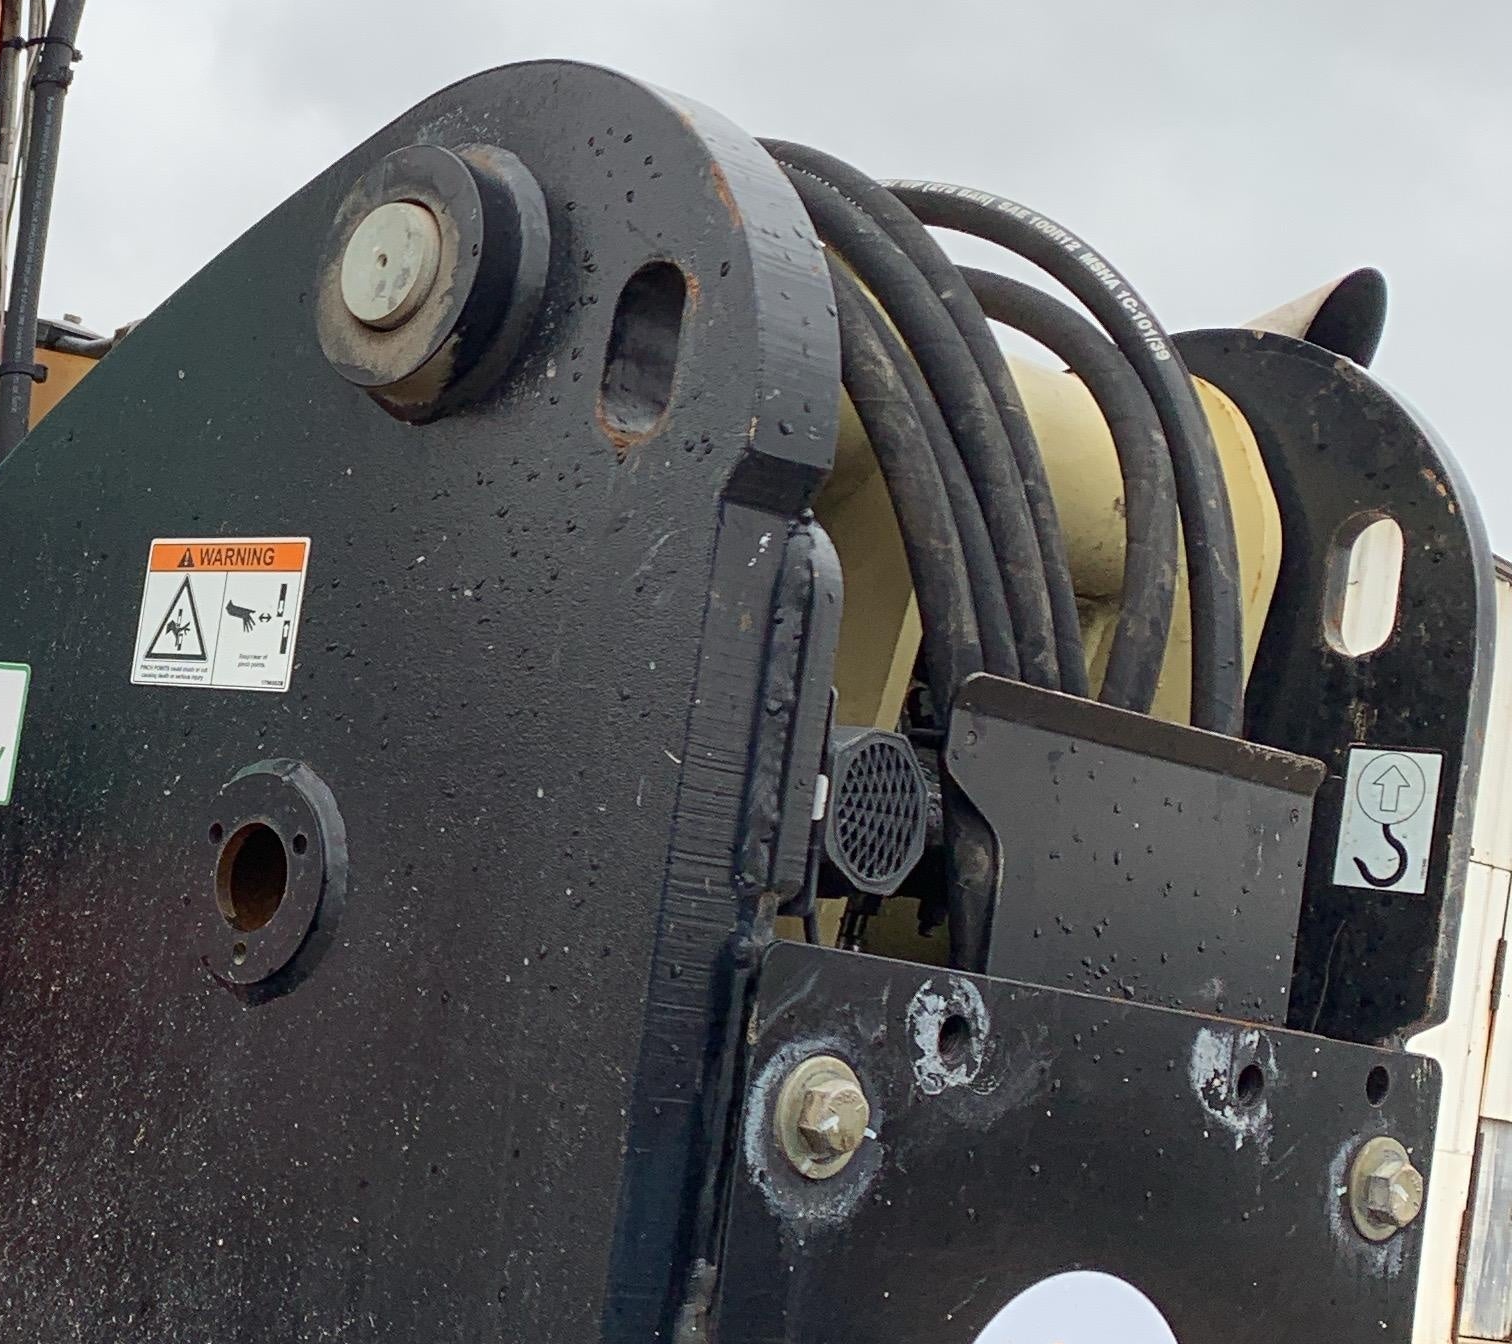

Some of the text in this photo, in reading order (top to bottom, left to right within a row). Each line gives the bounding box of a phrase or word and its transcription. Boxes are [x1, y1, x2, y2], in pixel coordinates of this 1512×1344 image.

[998, 201, 1031, 220] SAE
[1029, 216, 1083, 253] 100R12
[1079, 252, 1122, 291] MSHA
[199, 547, 276, 567] WARNING
